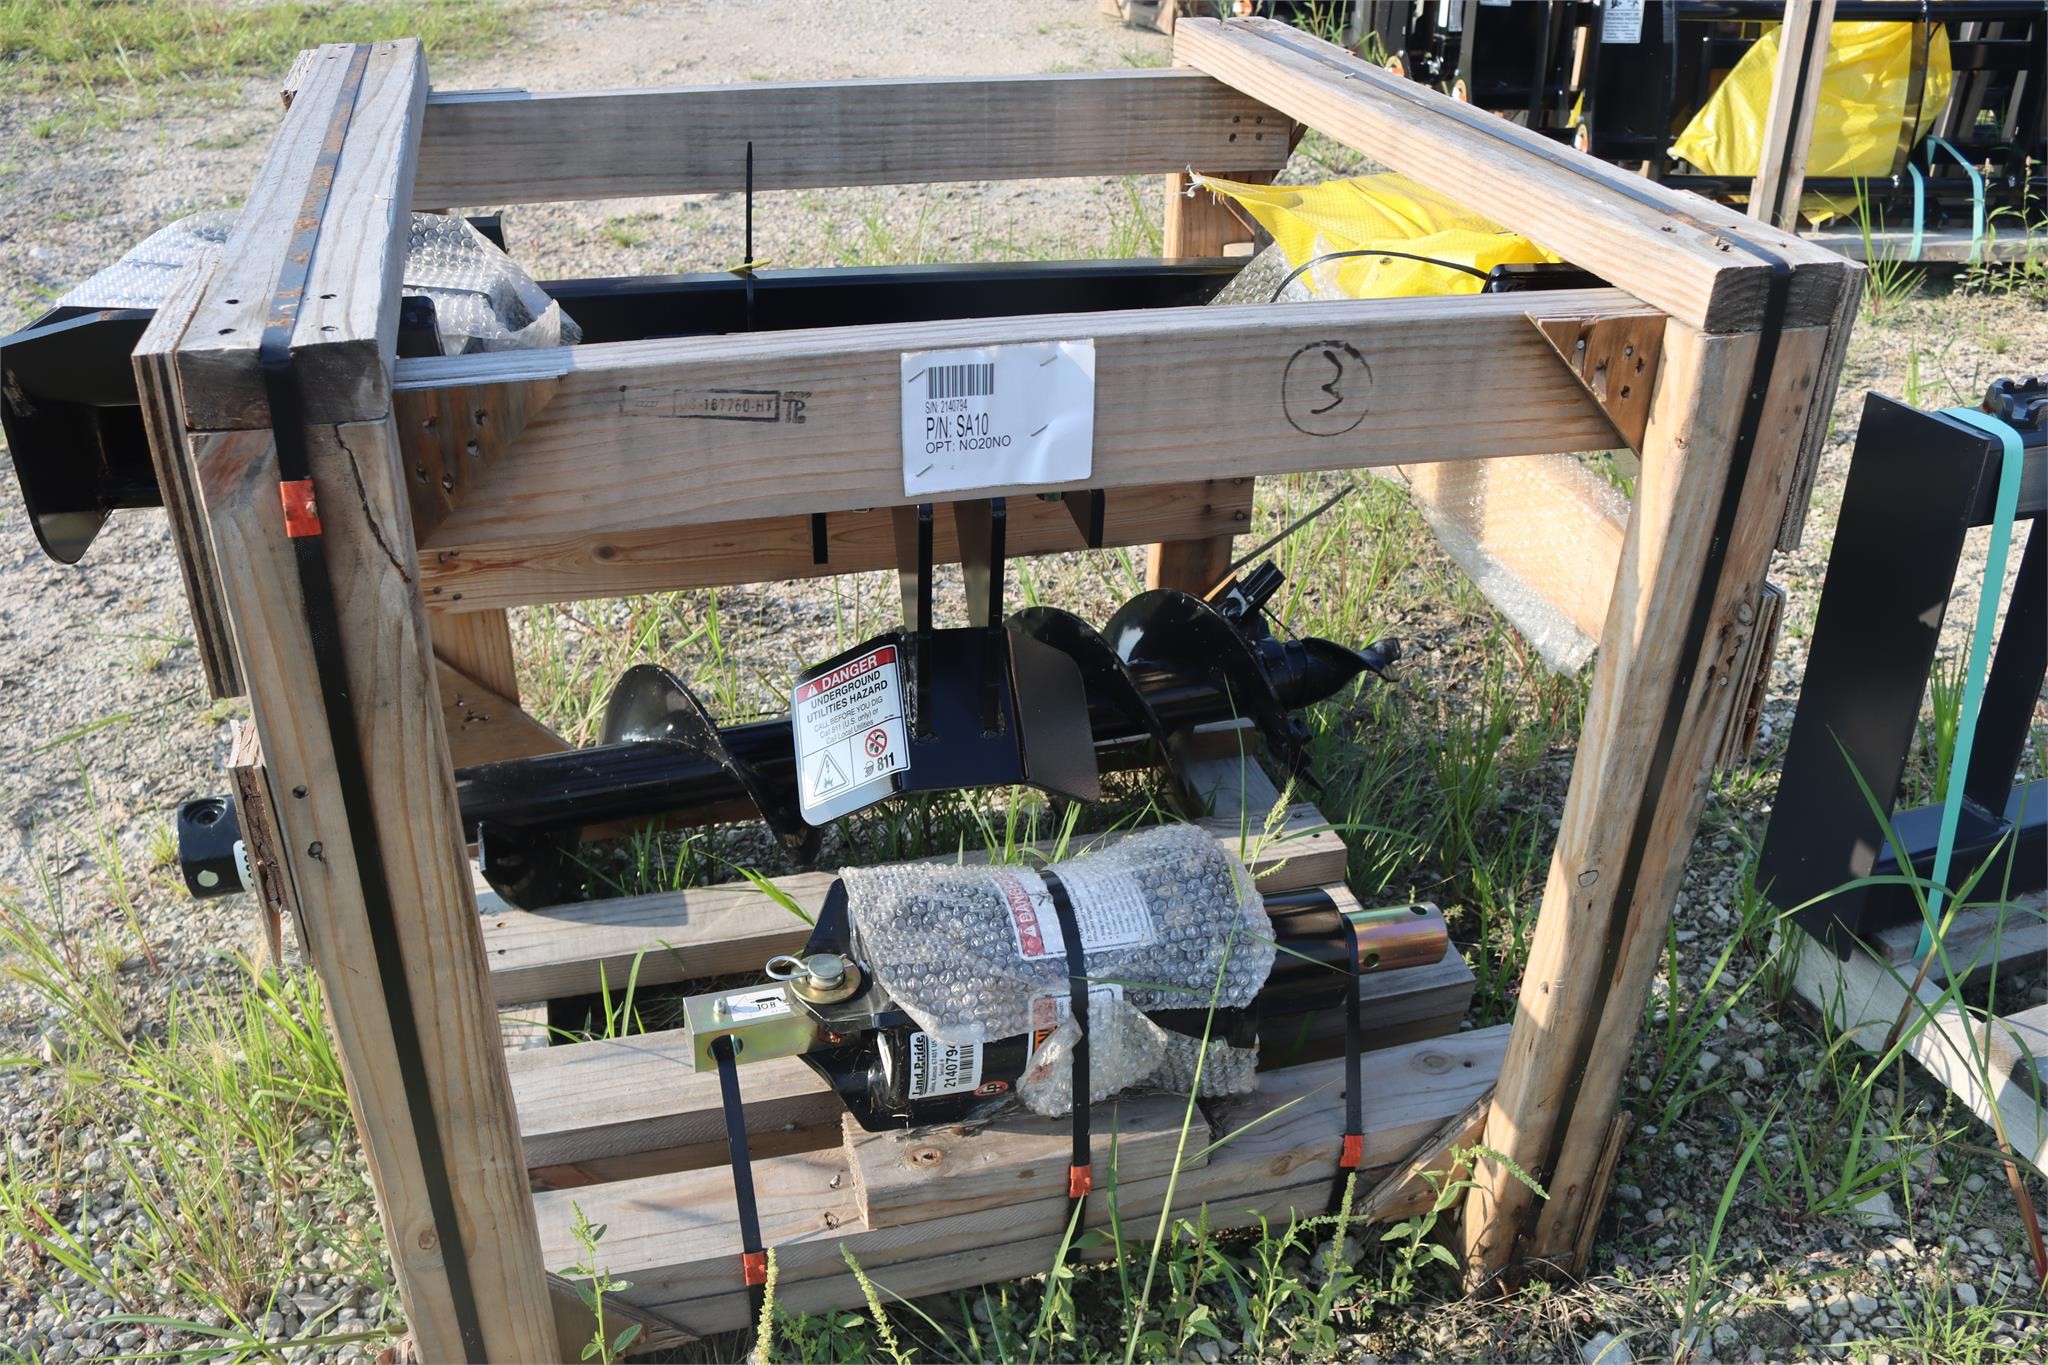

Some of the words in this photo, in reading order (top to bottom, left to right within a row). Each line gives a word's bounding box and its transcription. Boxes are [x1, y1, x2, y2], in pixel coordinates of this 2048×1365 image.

[926, 416, 952, 440] P/N:
[956, 412, 989, 438] SA10
[925, 440, 955, 454] OPT:
[960, 435, 1011, 451] NO20NO
[821, 655, 878, 691] DANGER
[807, 698, 848, 723] UTILITIES
[849, 680, 888, 704] HAZARD
[811, 670, 881, 709] UNDERGROUND
[830, 708, 856, 725] BEFORE
[857, 701, 871, 714] YOU
[871, 695, 884, 707] DIG
[877, 752, 895, 771] 811
[912, 1073, 925, 1096] Land
